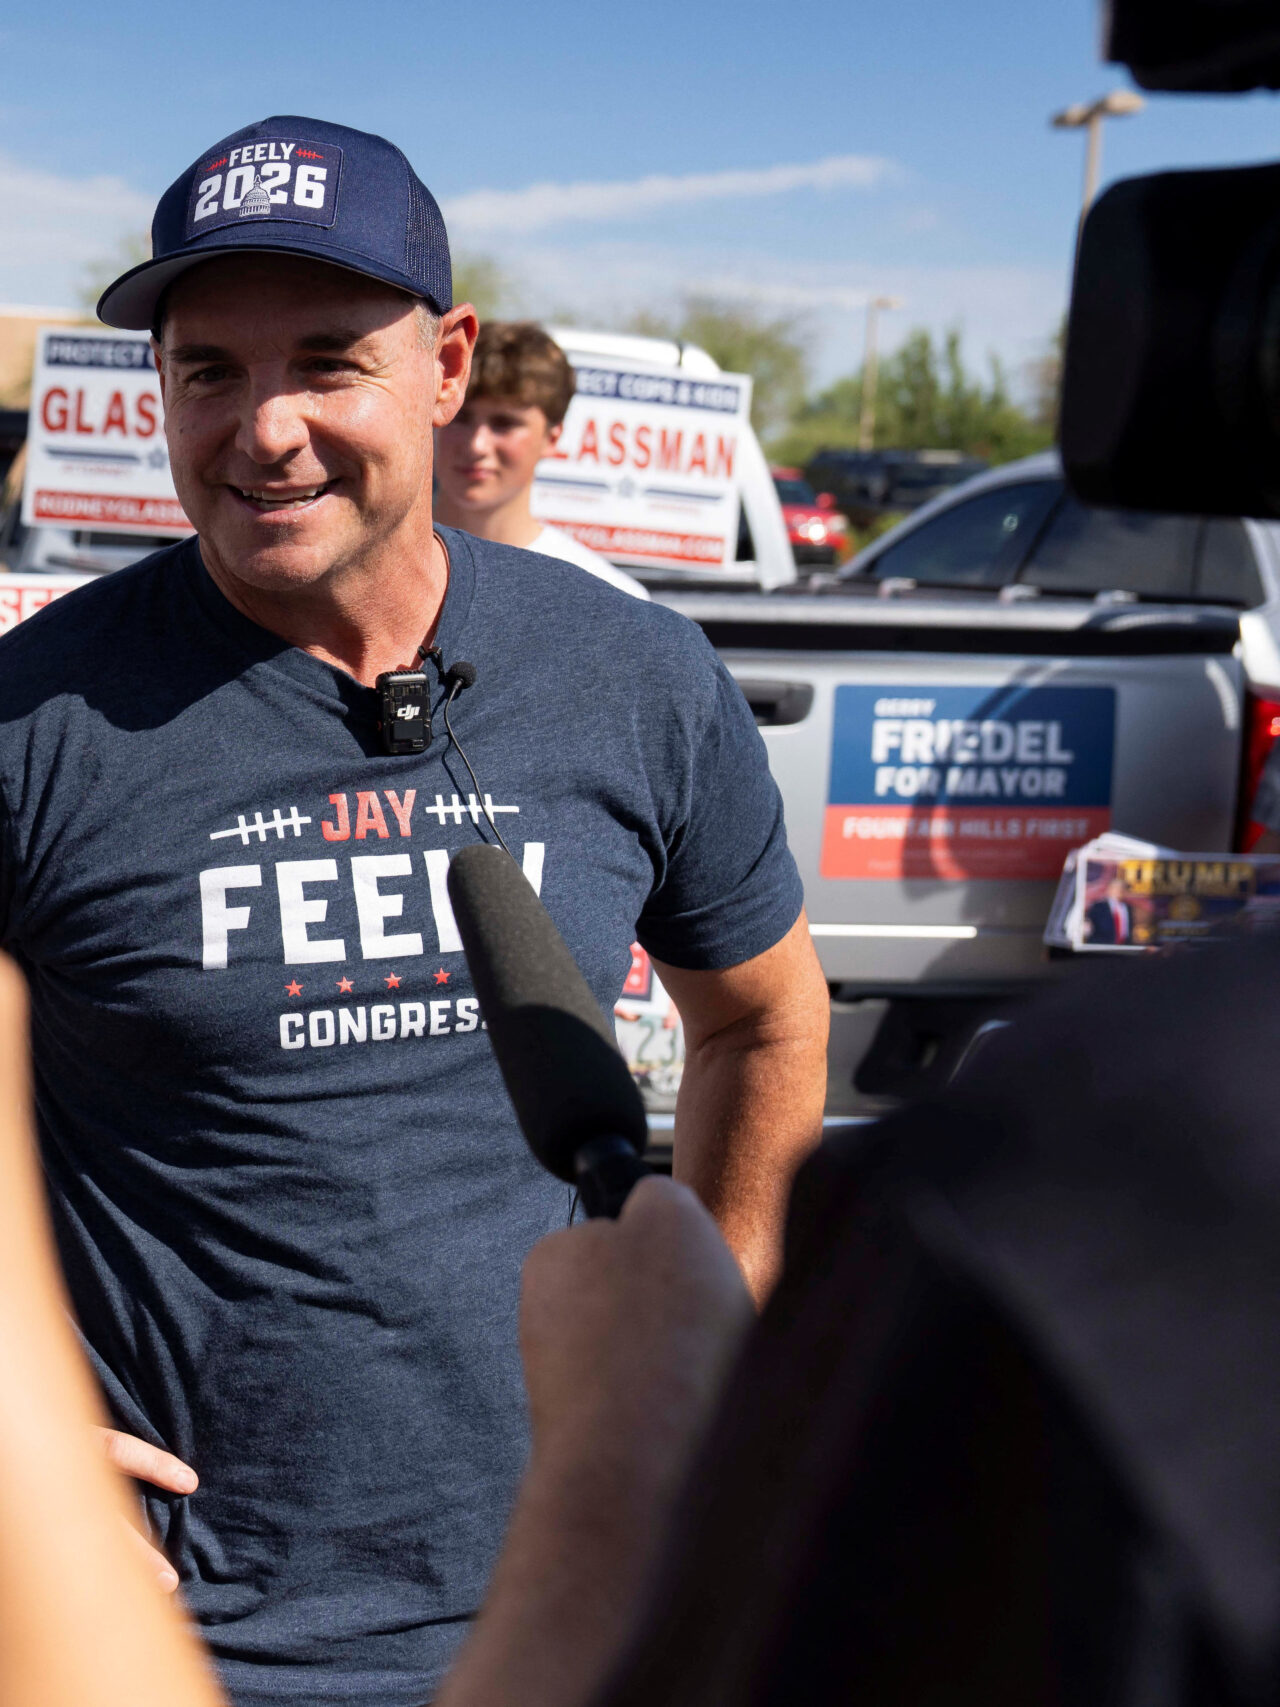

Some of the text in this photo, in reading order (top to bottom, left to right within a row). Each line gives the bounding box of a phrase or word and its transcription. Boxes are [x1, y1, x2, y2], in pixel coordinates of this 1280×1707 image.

[229, 143, 295, 167] FEELY
[194, 162, 328, 222] 2026
[41, 386, 157, 438] GLAS
[871, 719, 1074, 764] FRIEDEL
[874, 766, 1067, 797] FOR MAYOR
[321, 789, 417, 842] JAY
[842, 816, 1089, 839] FOUNTAIN HILLS FIRST
[279, 998, 488, 1050] CONGRES
